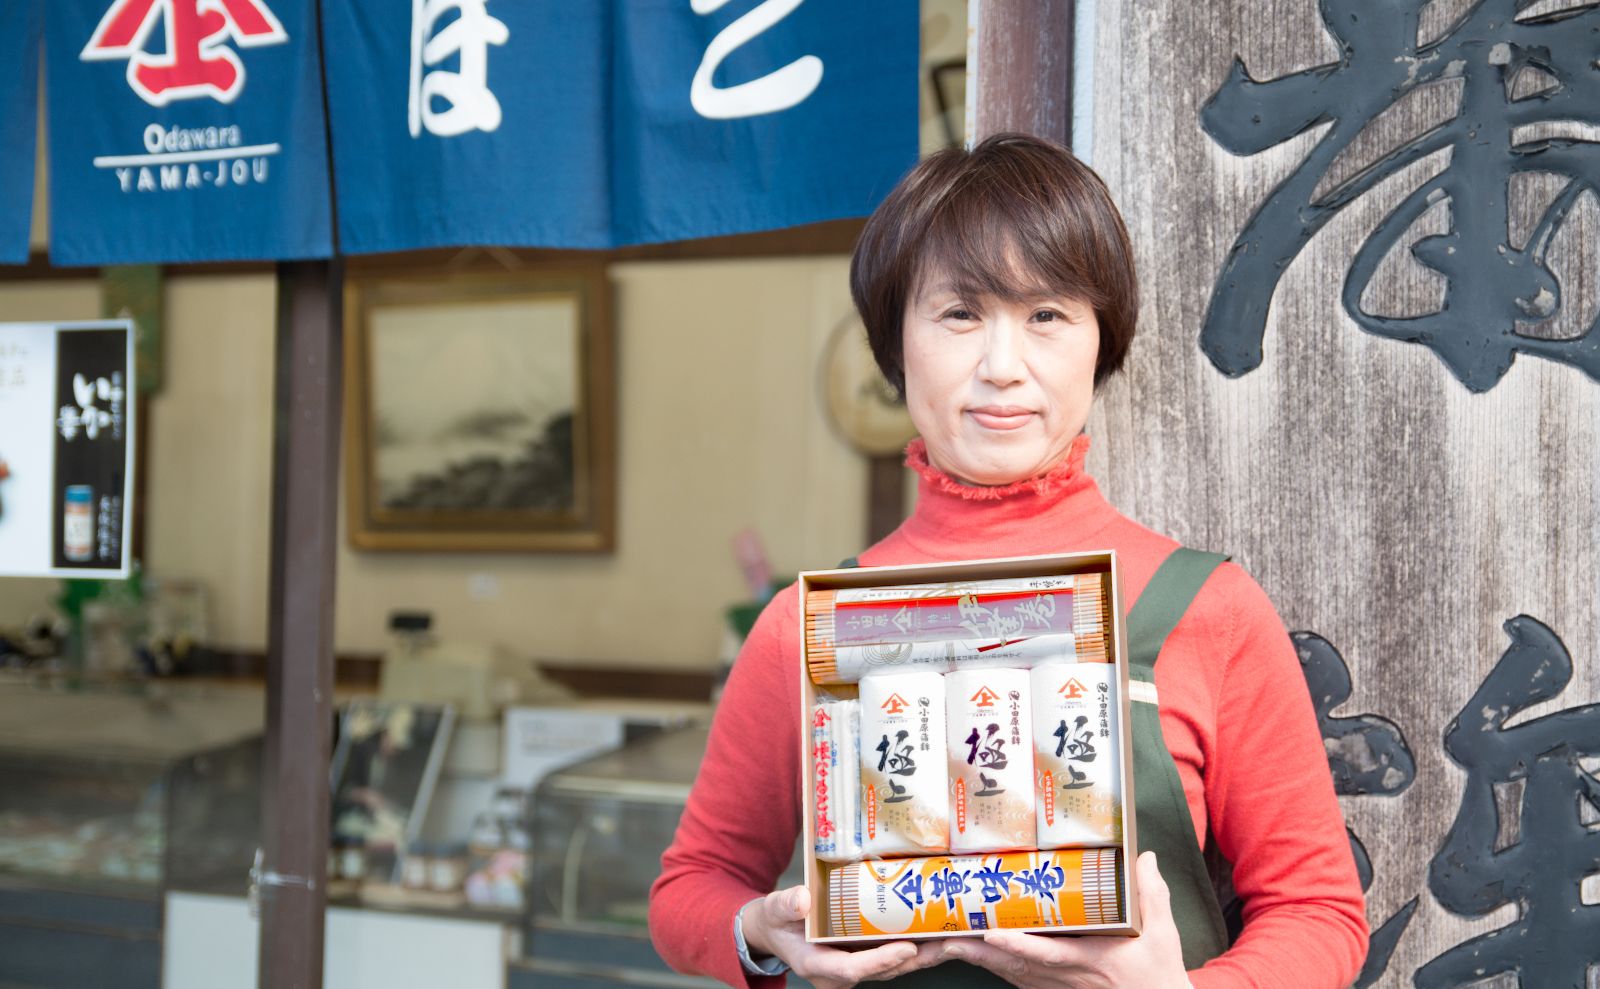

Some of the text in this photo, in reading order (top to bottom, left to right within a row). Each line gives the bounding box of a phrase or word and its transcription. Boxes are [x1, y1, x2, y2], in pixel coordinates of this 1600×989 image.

[143, 123, 241, 154] Odawara
[957, 593, 1057, 641] 伊達巻
[876, 729, 917, 803] 極上
[965, 723, 1008, 797] 極上
[1053, 715, 1097, 790] 極上
[929, 858, 1065, 910] 黄味巻
